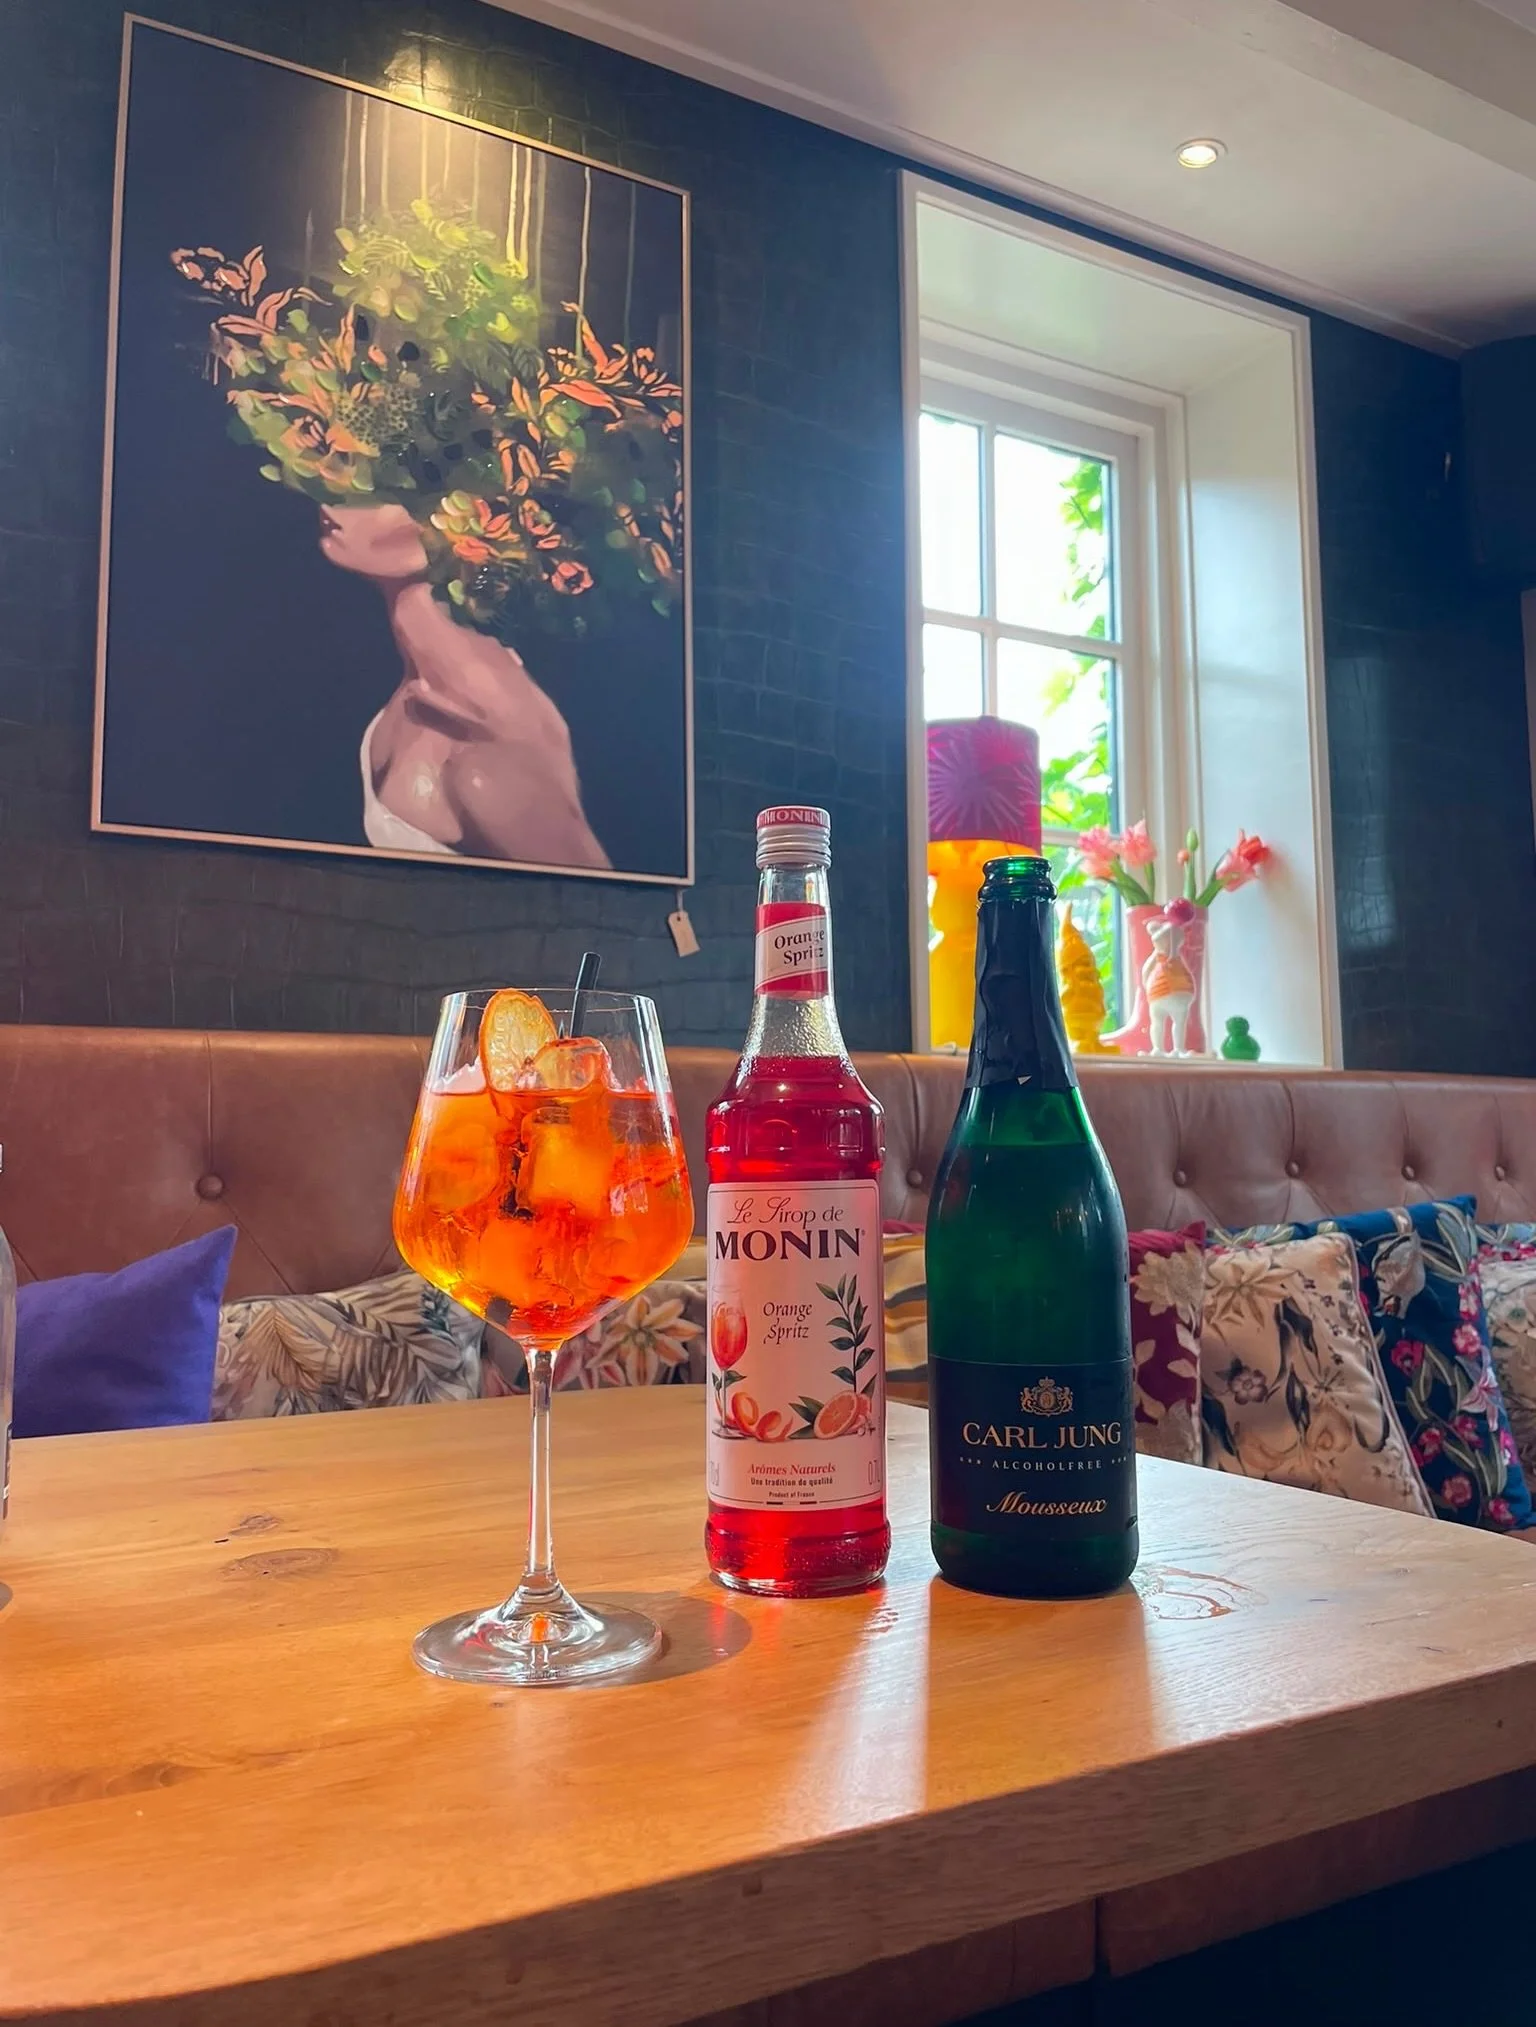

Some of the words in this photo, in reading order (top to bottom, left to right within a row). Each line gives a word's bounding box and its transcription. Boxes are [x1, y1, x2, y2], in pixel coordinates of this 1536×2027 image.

[765, 810, 824, 824] MONIN
[774, 929, 825, 949] Orange
[727, 1197, 754, 1224] Le
[759, 1196, 816, 1229] Sirop
[822, 1206, 844, 1222] de
[715, 1228, 860, 1261] MONIN
[763, 1302, 813, 1322] Orange
[763, 1318, 810, 1345] Spritz
[962, 1422, 1047, 1449] CARL
[1054, 1422, 1121, 1449] JUNG
[747, 1463, 788, 1475] Arômes
[790, 1462, 837, 1476] Naturels
[992, 1459, 1102, 1471] ALCOHOLFREE
[765, 1478, 797, 1487] tradition
[986, 1491, 1108, 1515] Mousseux
